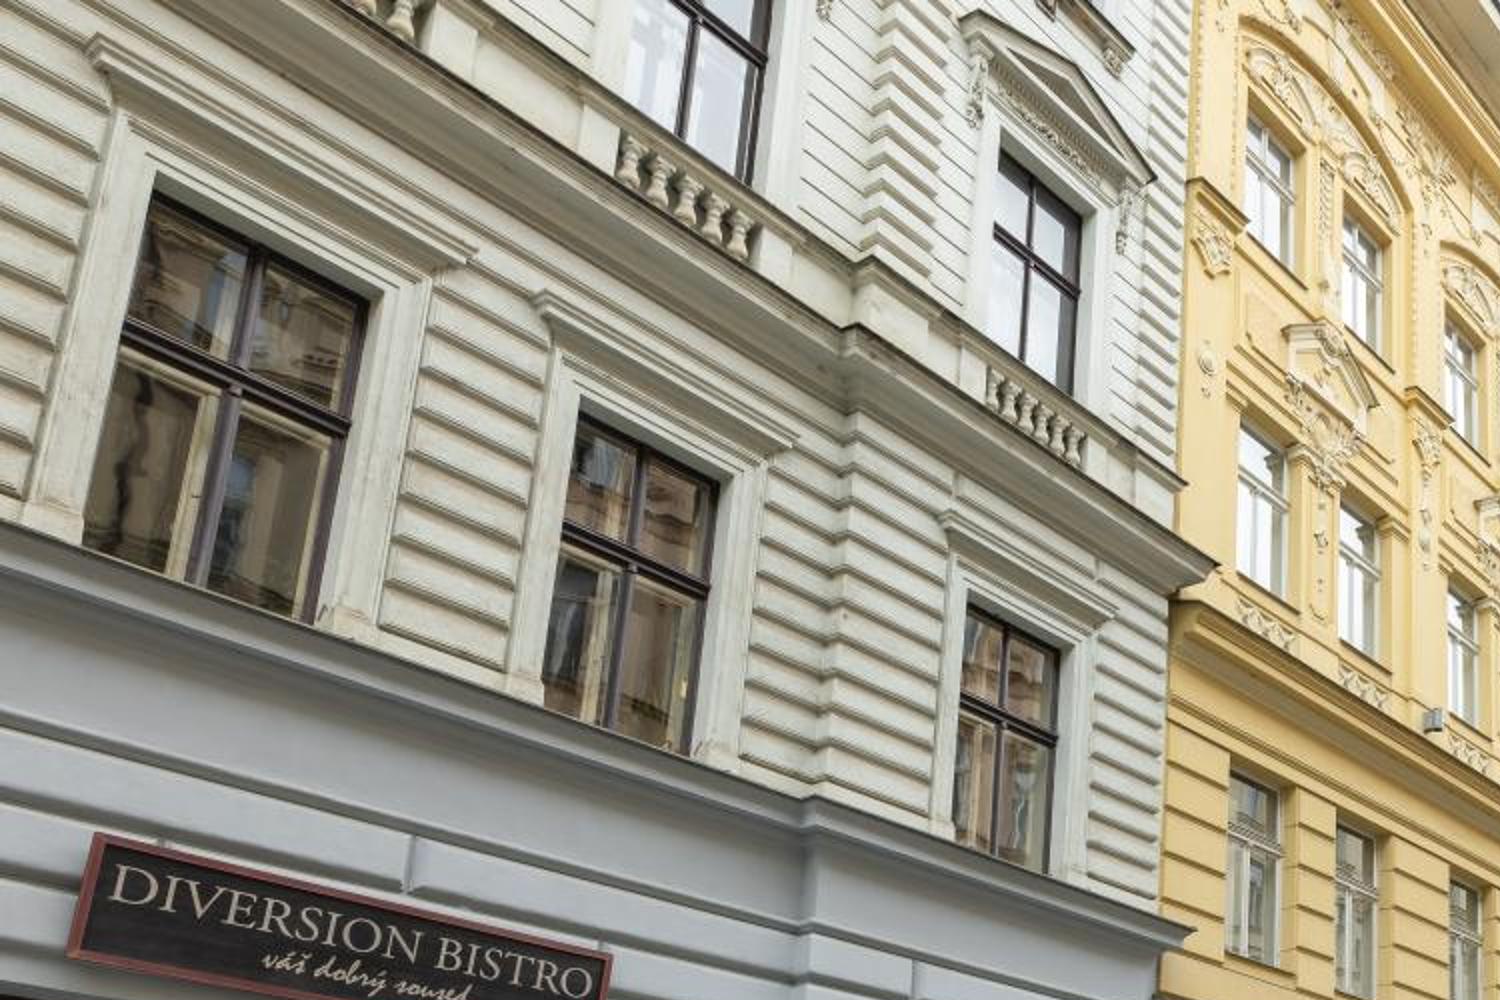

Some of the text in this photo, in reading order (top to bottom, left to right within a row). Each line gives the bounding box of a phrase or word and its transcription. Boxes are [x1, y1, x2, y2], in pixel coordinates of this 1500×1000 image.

[108, 864, 593, 1000] DIVERSION BISTRO
[262, 950, 309, 975] váš
[314, 955, 387, 998] dobrý
